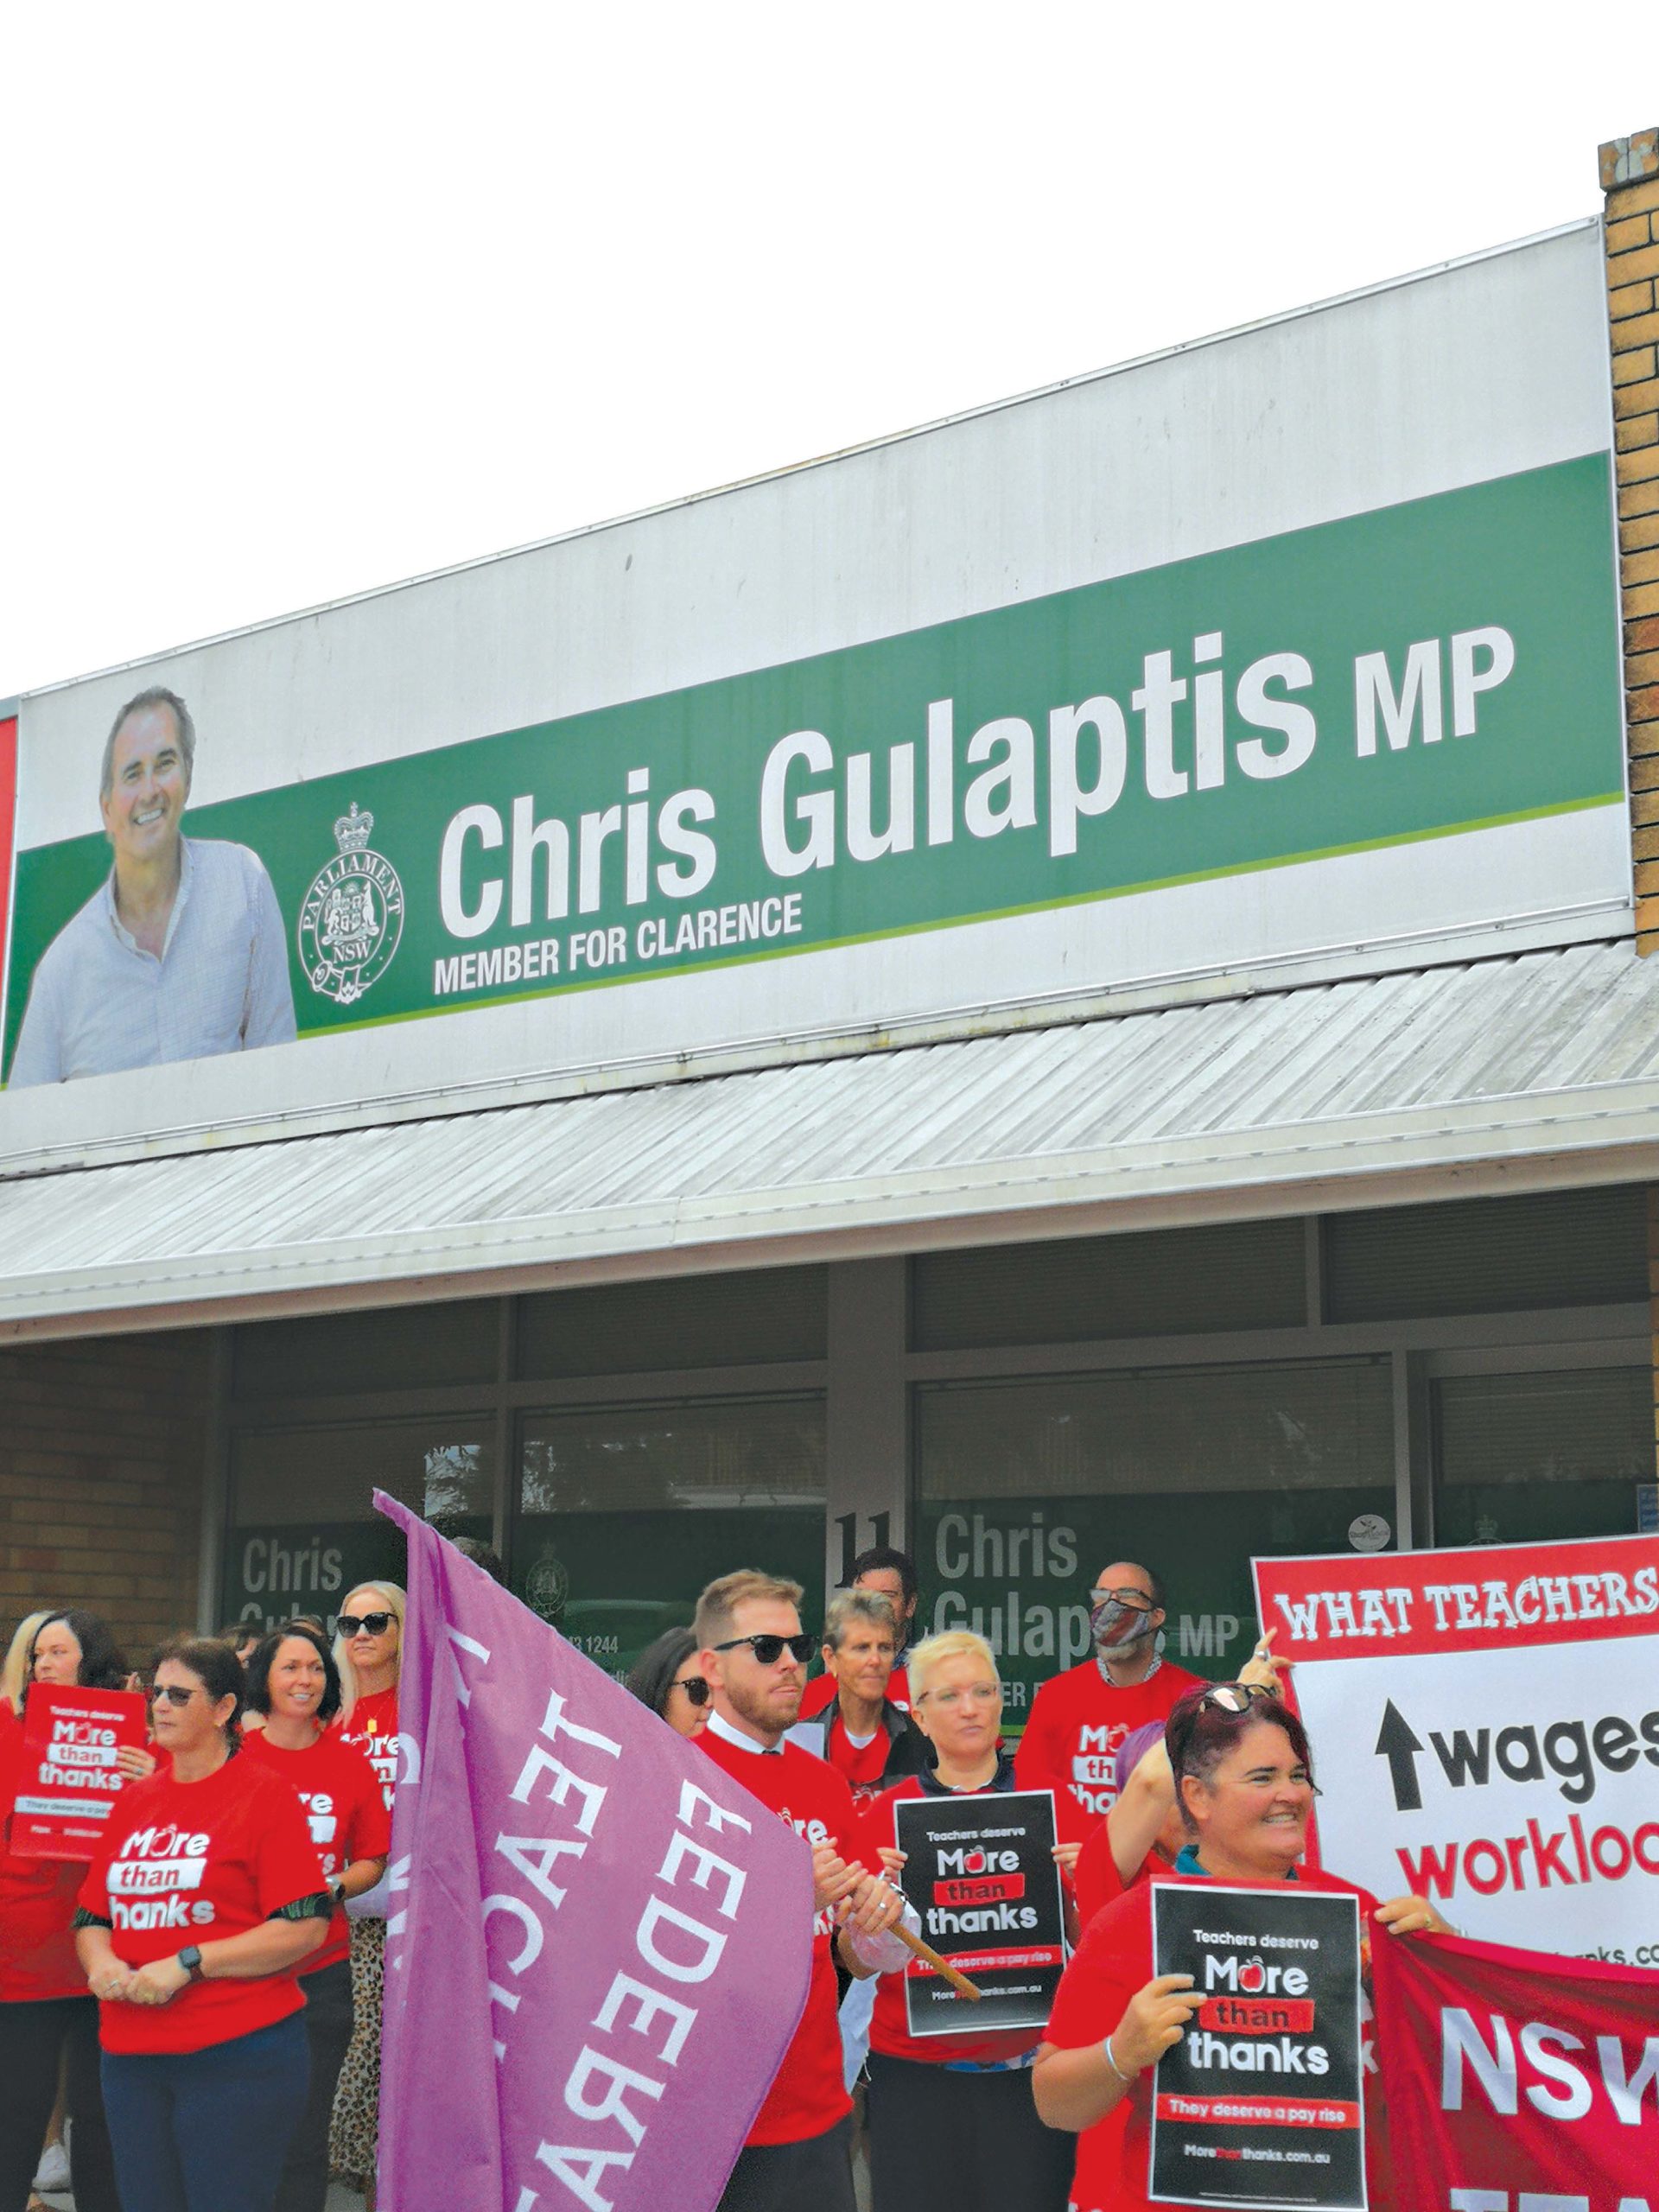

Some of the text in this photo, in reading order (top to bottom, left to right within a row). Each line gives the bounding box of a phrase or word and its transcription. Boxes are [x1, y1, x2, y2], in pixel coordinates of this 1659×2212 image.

[440, 625, 1516, 939] Chris Gulaptis MP
[302, 853, 403, 931] PARLIAMENT
[333, 940, 372, 964] NSW
[434, 893, 803, 995] MEMBER FOR CLARENCE
[936, 1512, 1077, 1579] Chris
[243, 1537, 343, 1592] Chris
[1274, 1567, 1659, 1641] WHAT TEACHERS
[586, 1636, 619, 1653] 1244
[1179, 1614, 1239, 1657] MP
[53, 1720, 117, 1746] More
[60, 1746, 103, 1764] than
[1087, 1759, 1113, 1779] th
[39, 1762, 124, 1791] thanks
[120, 1823, 211, 1858] More
[926, 1827, 1026, 1842] Teachers deserve
[120, 1865, 180, 1887] than
[937, 1846, 1020, 1876] More
[948, 1880, 1006, 1900] than
[109, 1893, 215, 1930] hanks
[926, 1903, 1038, 1935] thanks
[1192, 1929, 1319, 1949] Teachers deserve
[1205, 1955, 1309, 1996] More
[1217, 1999, 1289, 2028] than
[1188, 2031, 1329, 2075] thanks
[1170, 2099, 1346, 2123] They deserve a pay rise
